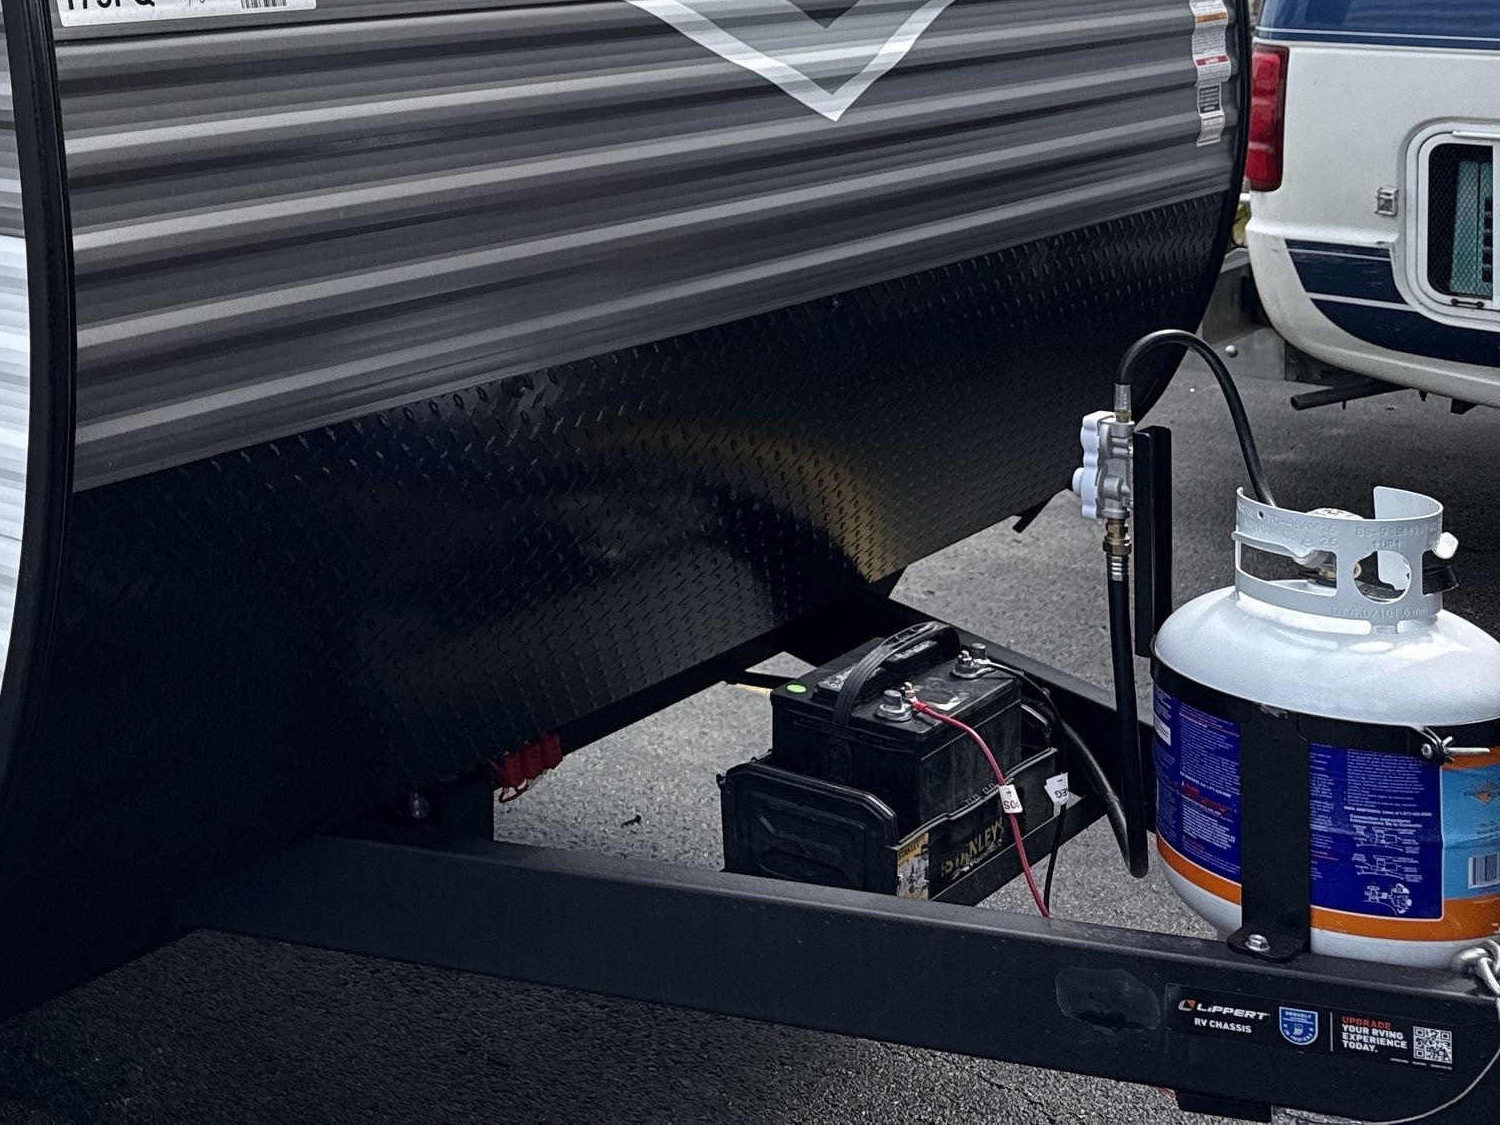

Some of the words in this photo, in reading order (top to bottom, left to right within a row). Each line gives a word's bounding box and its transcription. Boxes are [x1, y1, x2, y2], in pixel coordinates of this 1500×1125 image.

[1054, 788, 1069, 799] EG
[1194, 1017, 1208, 1027] RV
[1209, 1020, 1252, 1034] CHASSIS
[1342, 1015, 1392, 1030] UPGRADE
[1342, 1024, 1370, 1034] YOUR
[1371, 1028, 1404, 1041] RVING
[1341, 1040, 1379, 1053] TODAY.
[1342, 1032, 1408, 1050] EXPERIENCE
